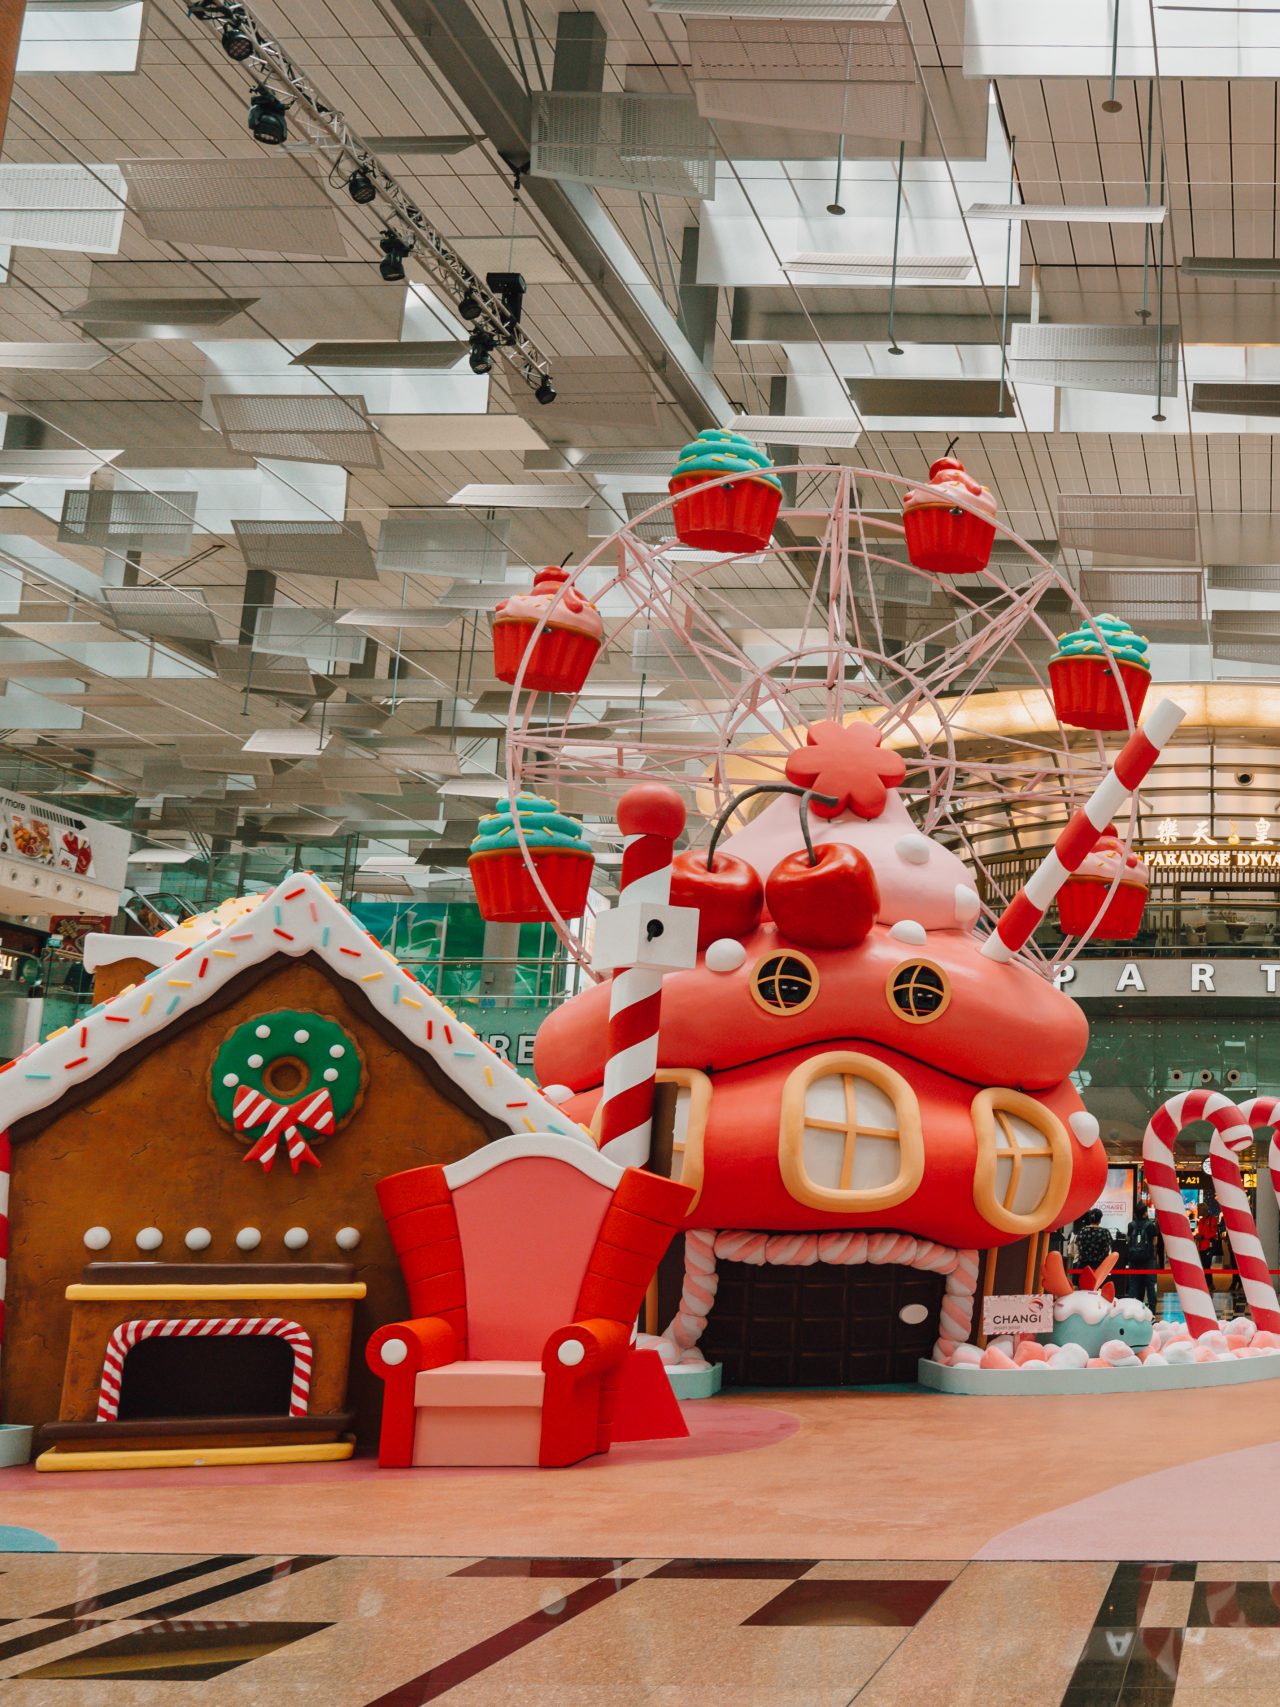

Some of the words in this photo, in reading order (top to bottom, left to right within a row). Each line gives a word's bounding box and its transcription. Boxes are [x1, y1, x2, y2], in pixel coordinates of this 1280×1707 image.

[5, 798, 26, 811] more
[1144, 853, 1230, 866] PARADISE
[474, 1033, 537, 1065] RE
[993, 1313, 1041, 1324] CHANGI
